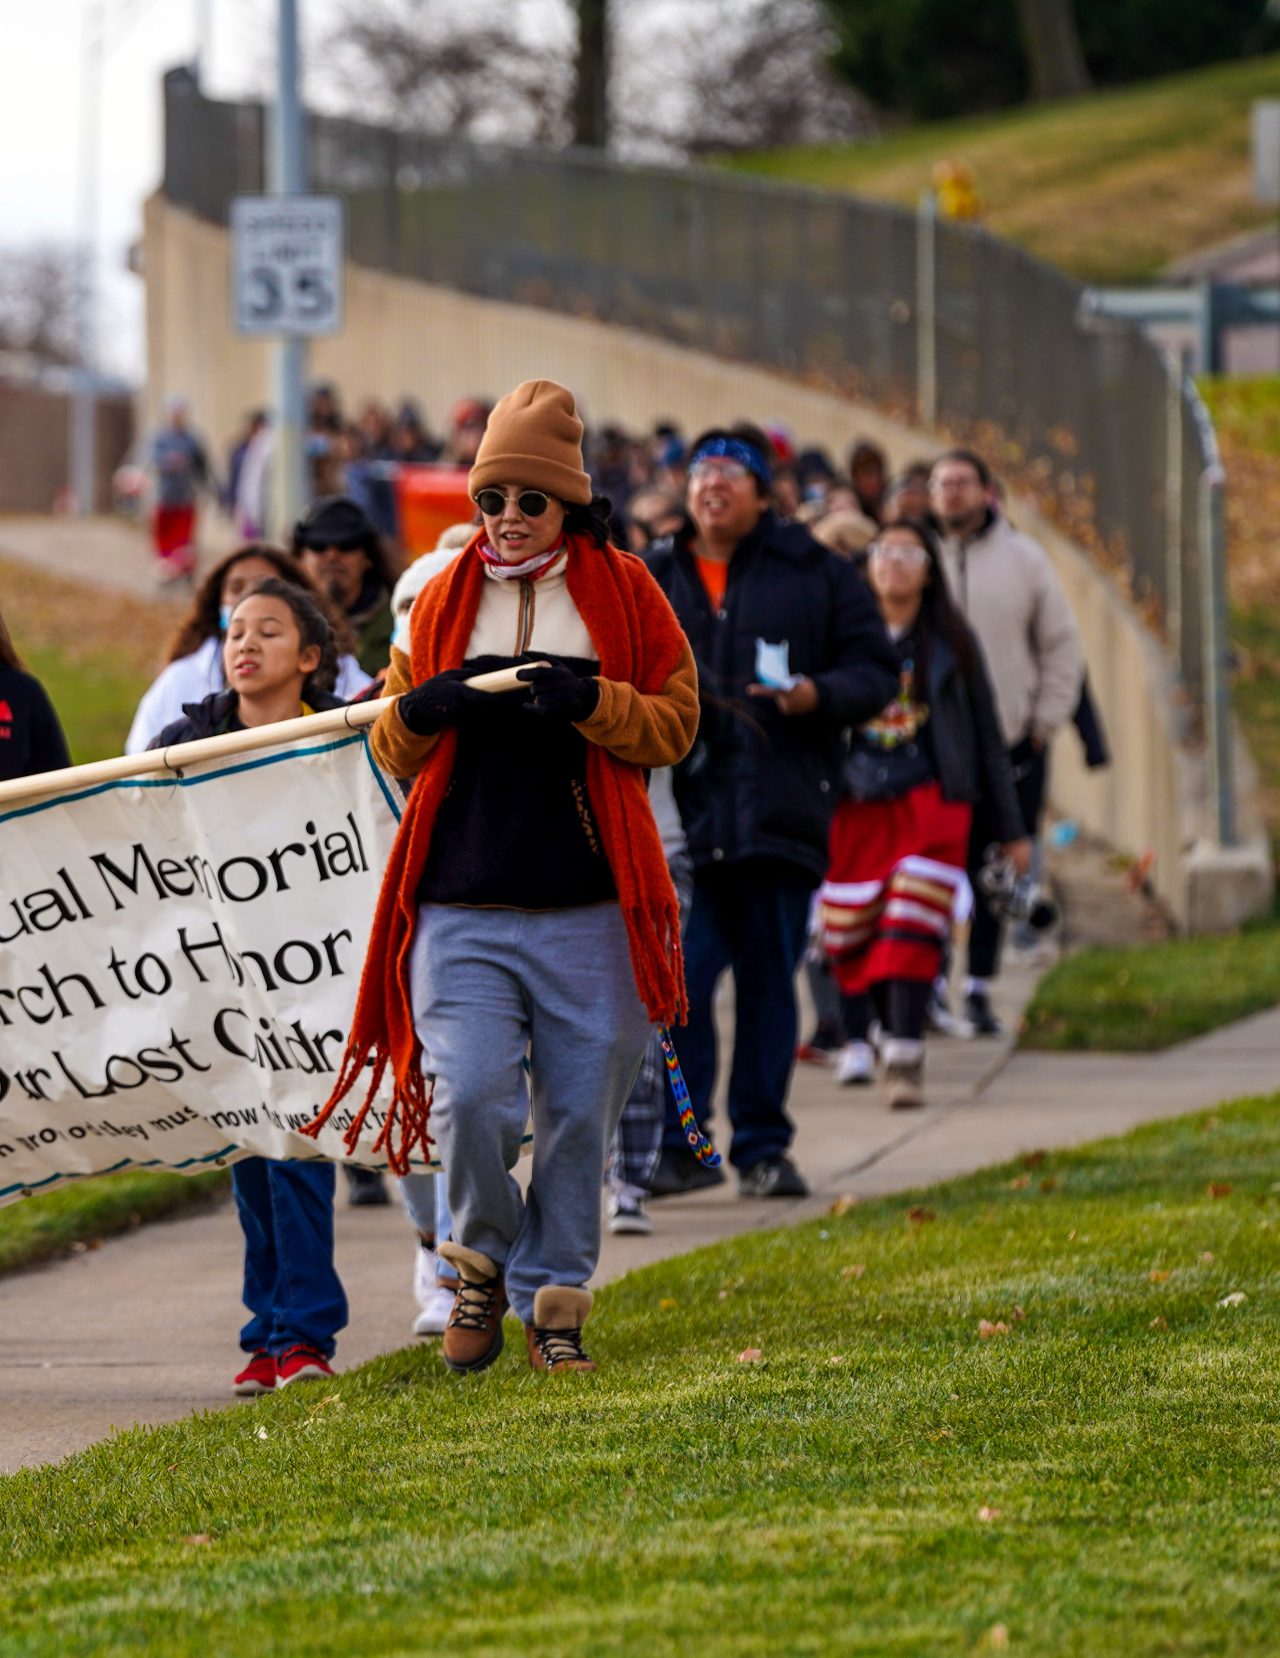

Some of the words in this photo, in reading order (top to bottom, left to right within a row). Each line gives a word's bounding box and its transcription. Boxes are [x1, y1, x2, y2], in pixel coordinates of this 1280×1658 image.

[247, 266, 334, 321] 35
[107, 946, 172, 999] to
[52, 1027, 212, 1098] Lost
[149, 1106, 199, 1132] mus
[205, 1107, 258, 1129] now
